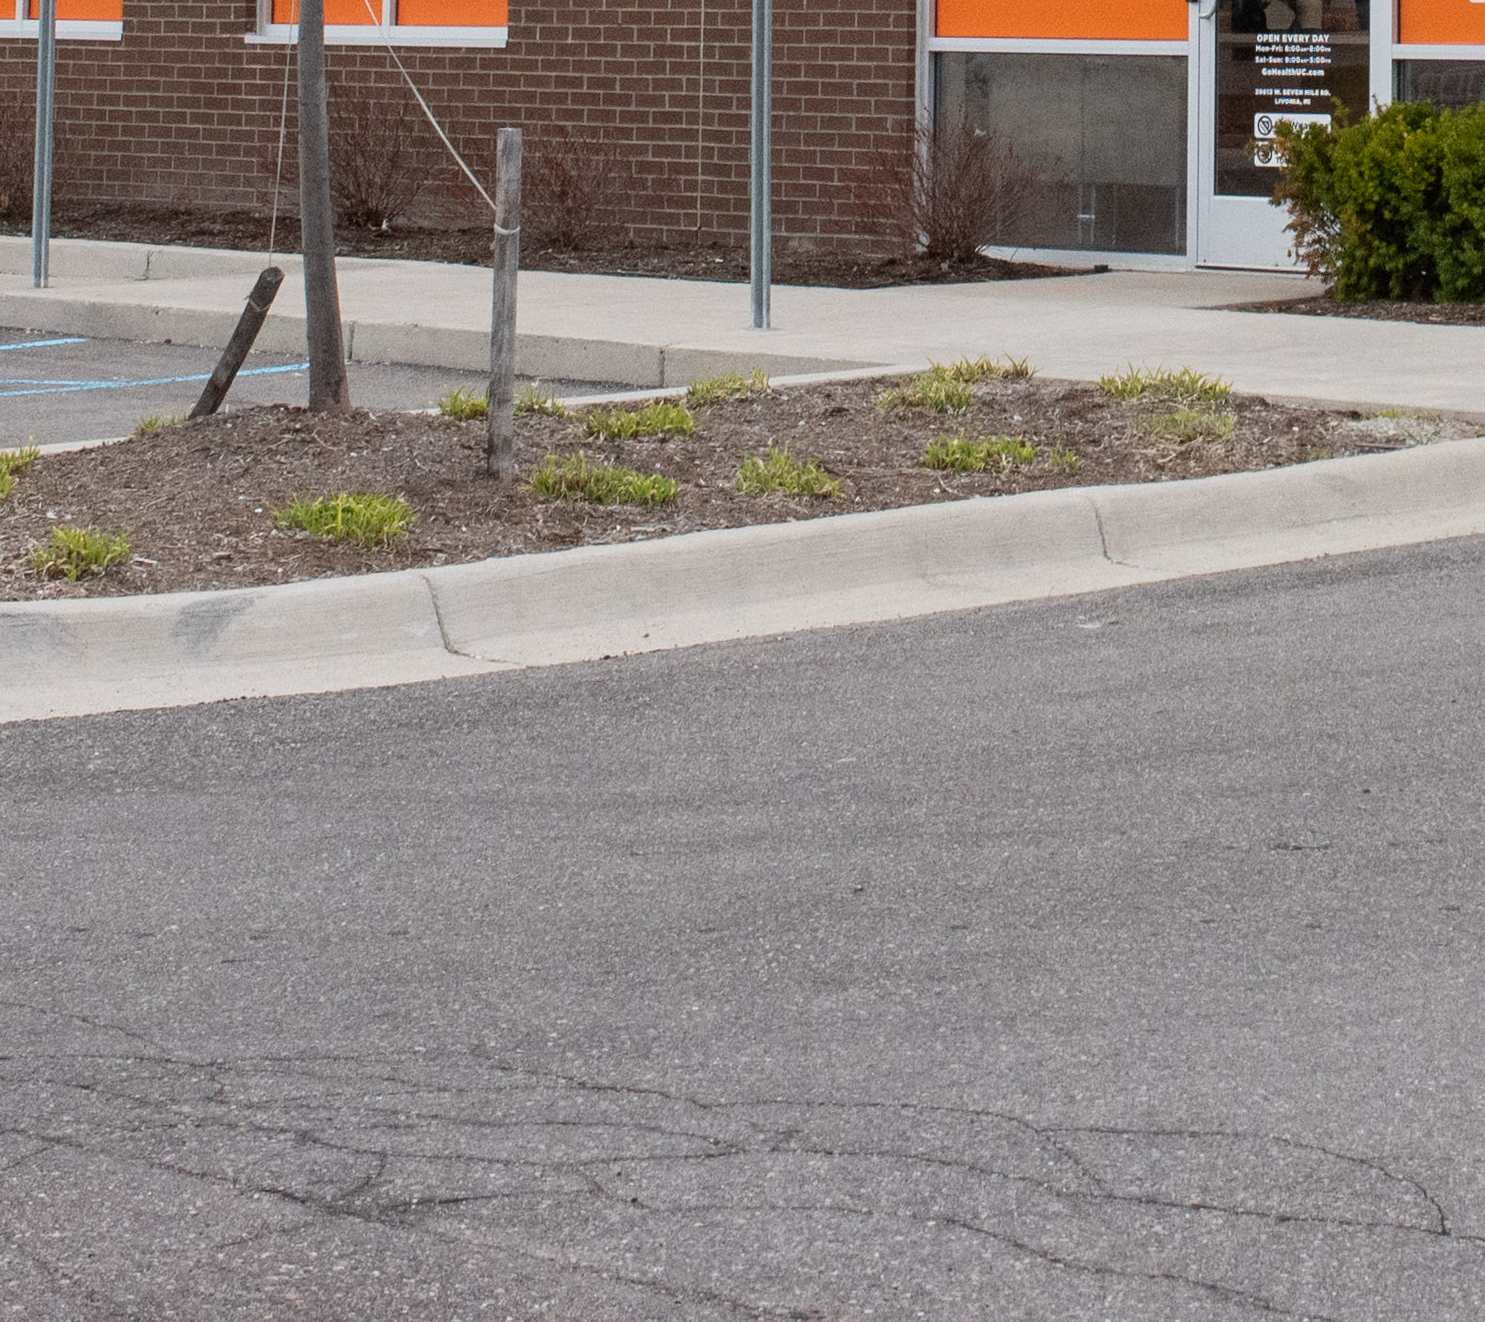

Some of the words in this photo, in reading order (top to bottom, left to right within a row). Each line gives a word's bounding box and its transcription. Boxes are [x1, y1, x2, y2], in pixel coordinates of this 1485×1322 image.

[1256, 34, 1280, 42] OPEN
[1282, 34, 1310, 43] EVERY
[1312, 34, 1330, 43] DAY
